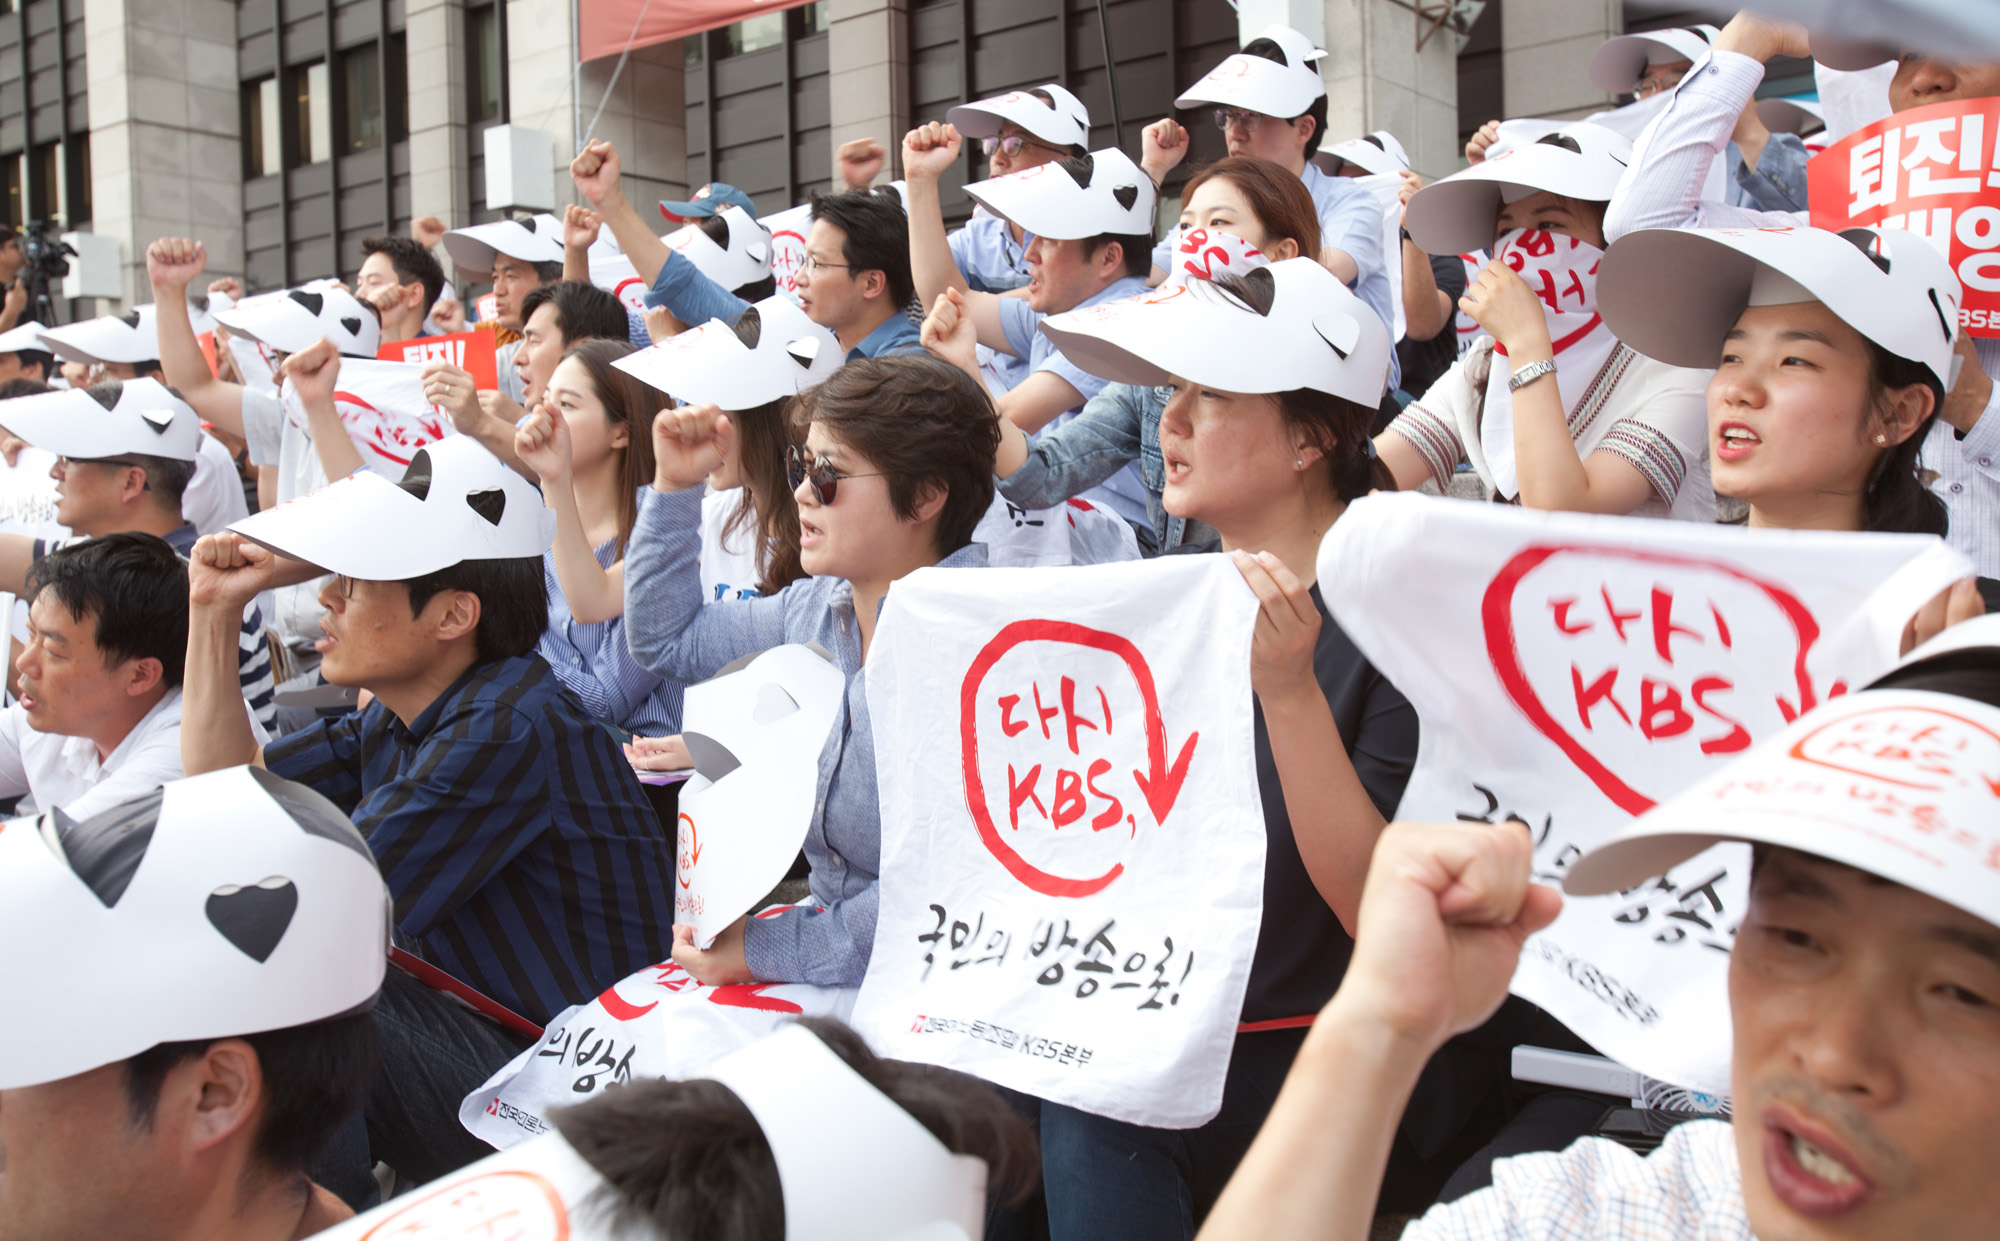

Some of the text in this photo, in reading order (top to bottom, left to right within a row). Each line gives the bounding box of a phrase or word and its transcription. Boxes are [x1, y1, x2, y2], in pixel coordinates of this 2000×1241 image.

[1548, 583, 1733, 664] 다시
[998, 674, 1113, 754] 다시
[918, 904, 1196, 1011] 국민의 방송으로!
